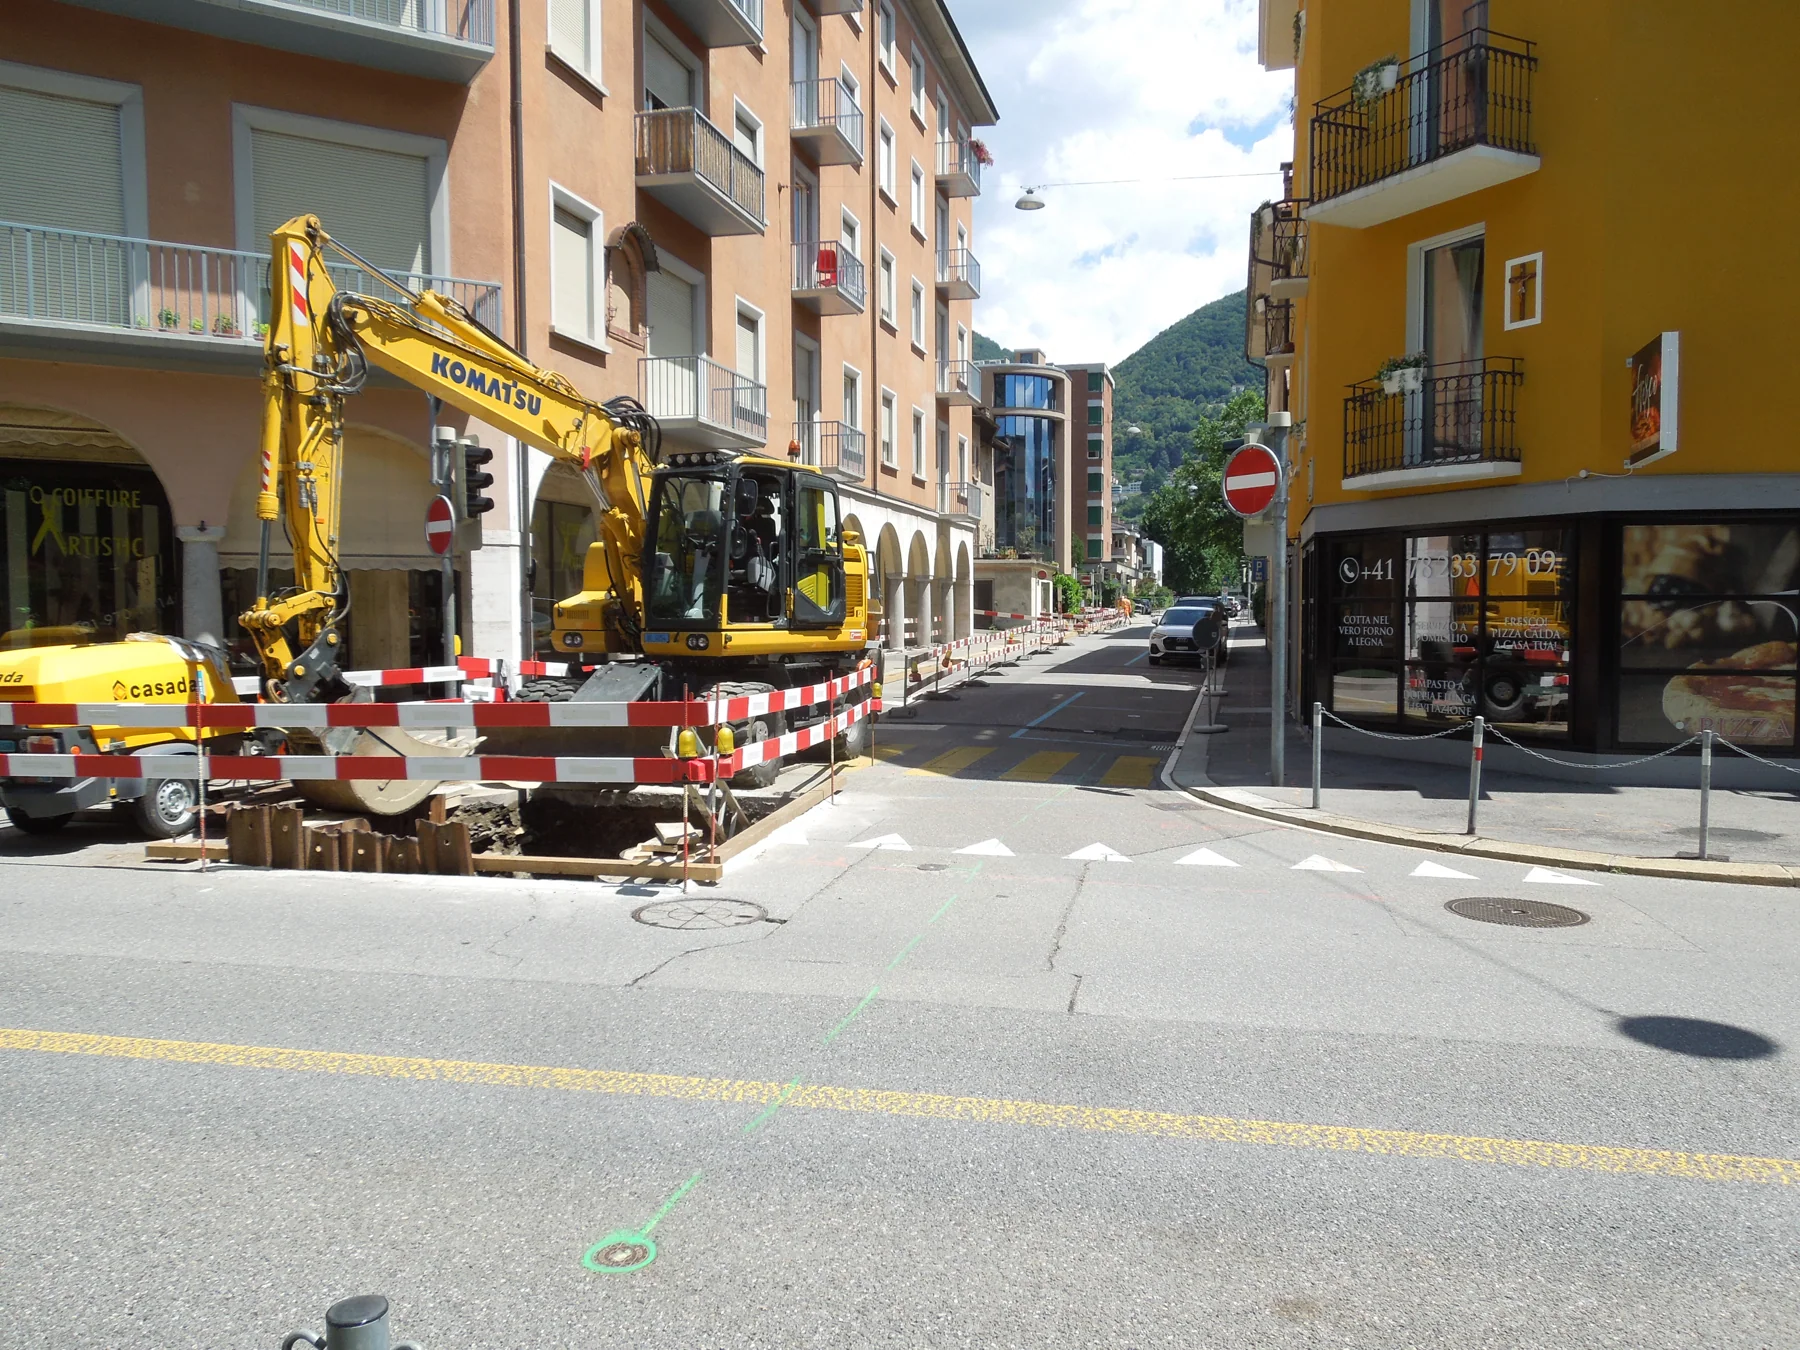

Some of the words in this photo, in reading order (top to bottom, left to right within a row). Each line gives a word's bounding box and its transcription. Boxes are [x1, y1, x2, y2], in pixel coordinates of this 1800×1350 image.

[431, 352, 542, 416] KOMATSU
[52, 488, 141, 508] COIFFURE
[1361, 558, 1394, 580] +41
[1407, 556, 1433, 579] 78
[1435, 553, 1477, 578] 233
[1490, 552, 1517, 577] 79
[1526, 550, 1556, 575] 09
[1343, 615, 1371, 625] COTTA
[1372, 615, 1389, 625] NEL
[1504, 616, 1549, 627] FRESCO!
[1338, 626, 1361, 635] VERO
[1363, 626, 1394, 636] FORNO
[1460, 622, 1467, 632] A
[1491, 628, 1522, 639] PIZZA
[1523, 629, 1561, 640] CALDA
[1347, 637, 1355, 646] A
[1355, 637, 1384, 647] LEGNA
[1502, 640, 1530, 651] CASA
[1532, 640, 1558, 651] TUA!
[130, 677, 198, 699] casada
[1415, 679, 1455, 690] IMPASTO
[1459, 681, 1465, 691] A
[1700, 717, 1792, 738] PIZZA
